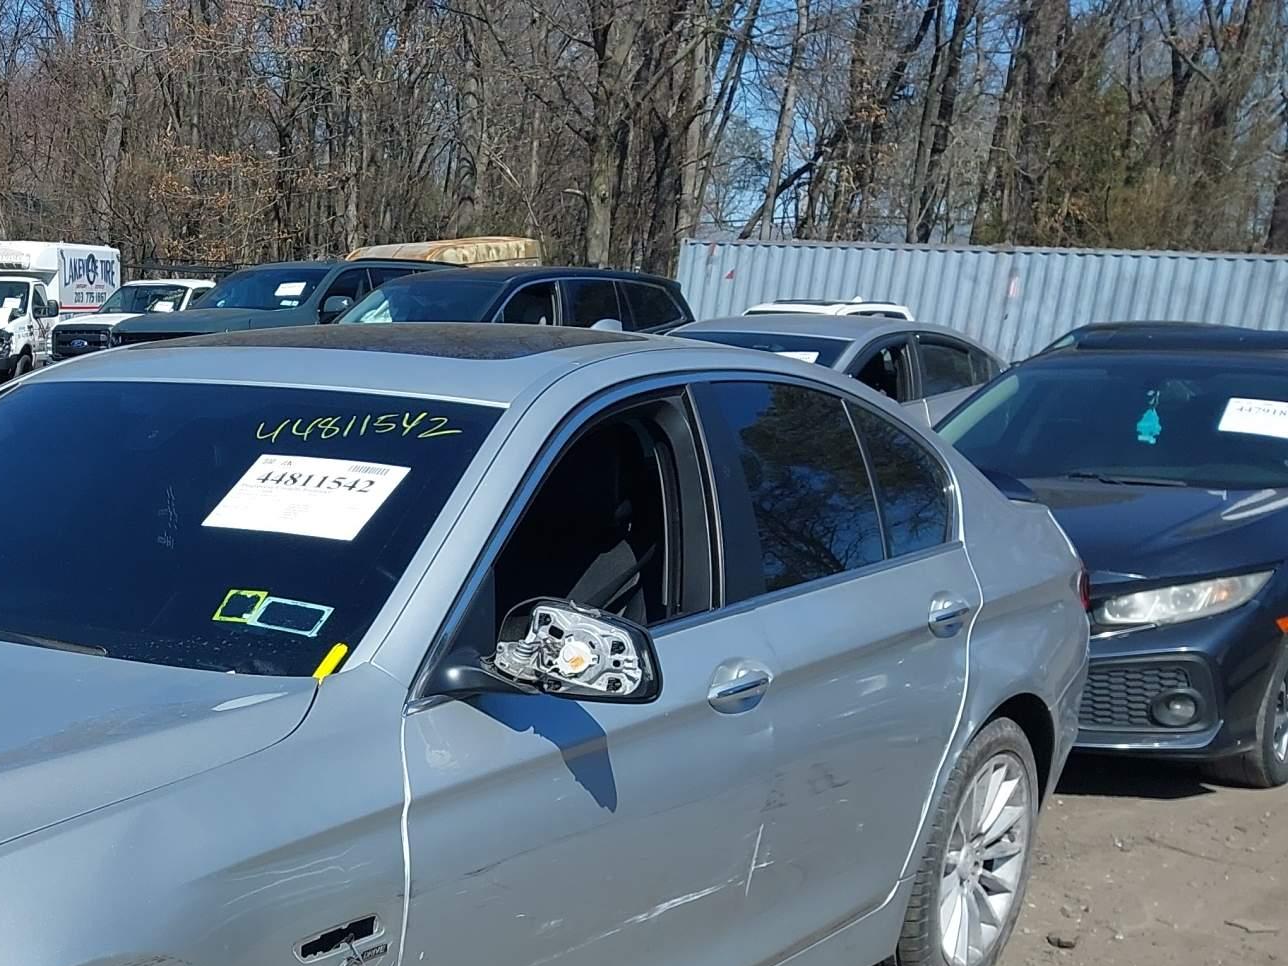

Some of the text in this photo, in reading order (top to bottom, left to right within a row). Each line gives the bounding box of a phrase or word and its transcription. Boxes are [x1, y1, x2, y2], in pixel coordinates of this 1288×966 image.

[100, 259, 116, 288] TIRE
[256, 411, 463, 443] 44811542
[257, 470, 376, 493] 44811542
